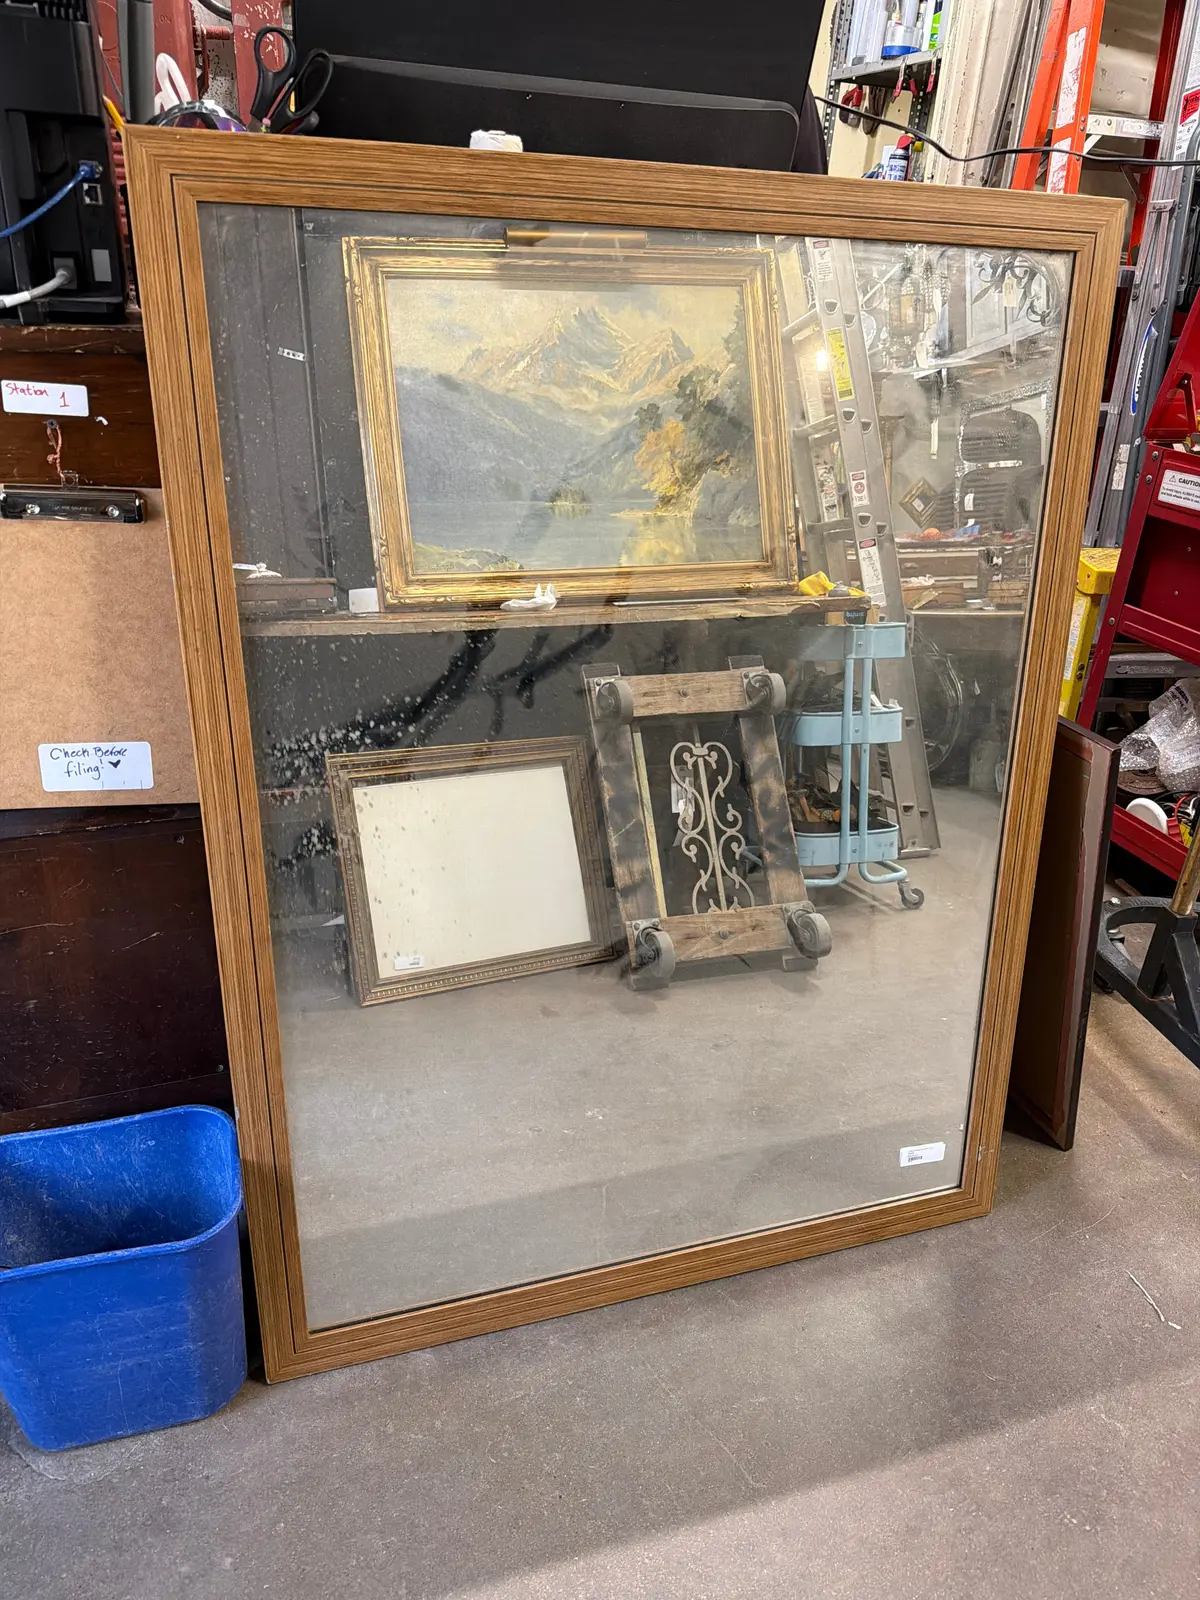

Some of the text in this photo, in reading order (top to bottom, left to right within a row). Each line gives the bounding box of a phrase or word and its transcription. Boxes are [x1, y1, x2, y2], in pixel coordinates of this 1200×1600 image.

[5, 382, 70, 408] Station 1
[93, 746, 128, 758] Before
[64, 759, 104, 780] filing!
